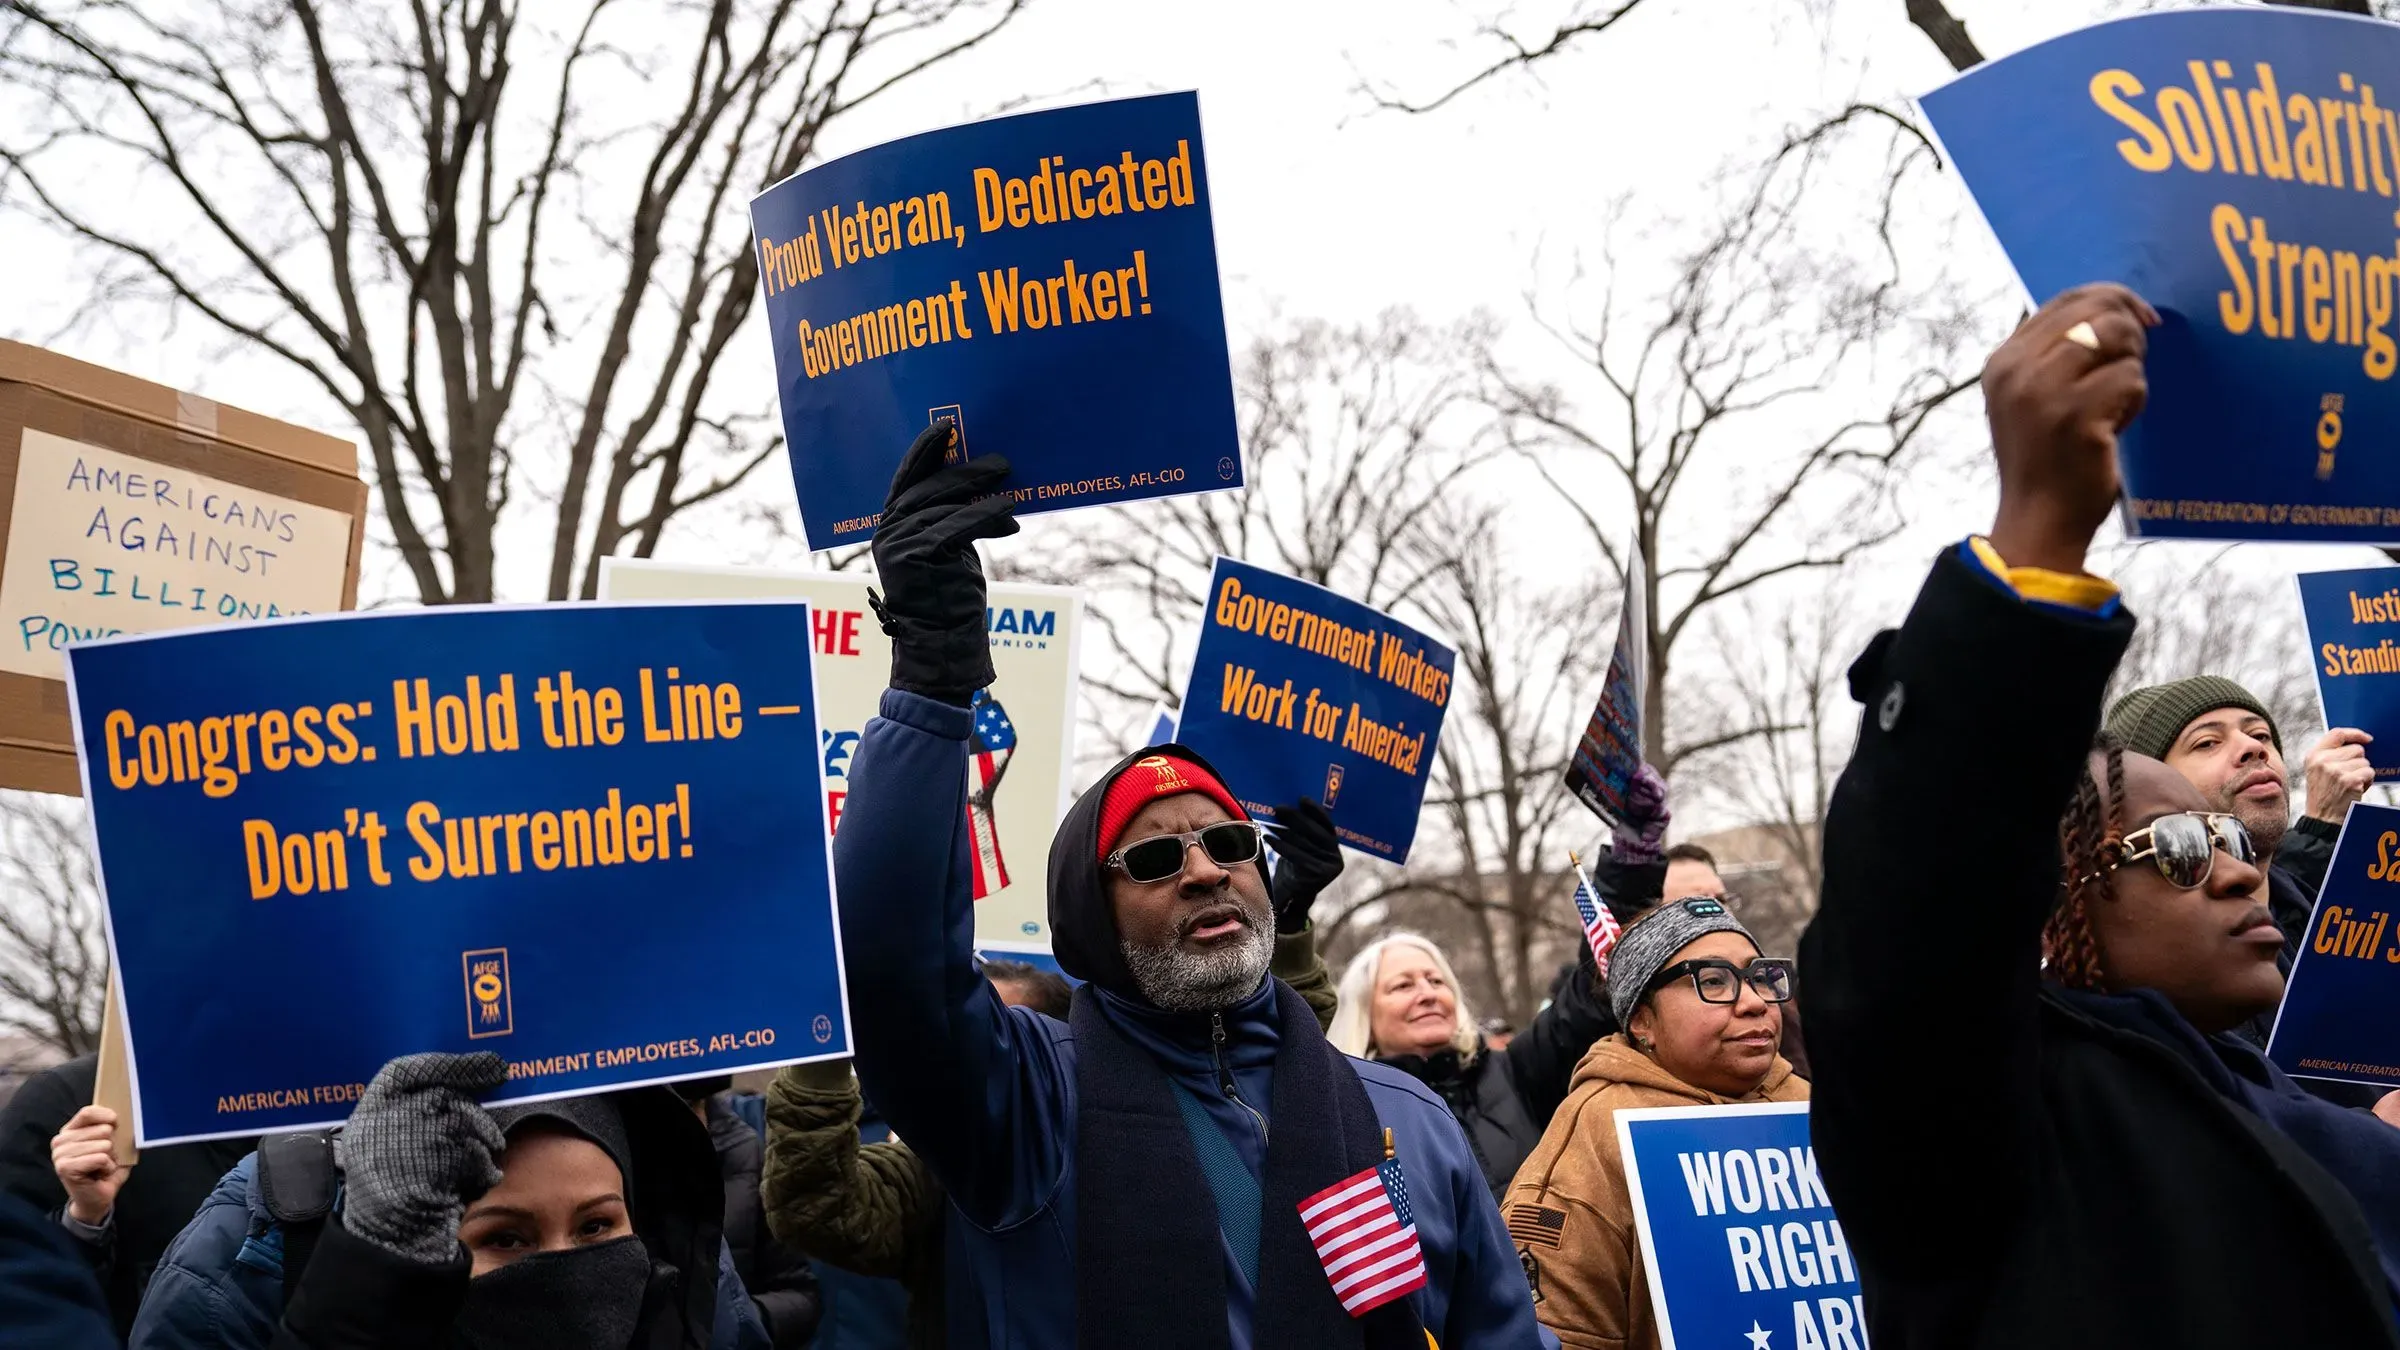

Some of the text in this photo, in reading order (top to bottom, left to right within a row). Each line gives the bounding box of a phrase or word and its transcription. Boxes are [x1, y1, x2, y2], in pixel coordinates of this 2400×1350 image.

[762, 139, 1196, 297] Proud Veteran, Dedicated
[799, 250, 1152, 379] Government Worker!
[2211, 203, 2400, 380] Streng
[66, 457, 298, 543] AMERICANS
[1037, 477, 1125, 499] EMPLOYEES,
[1129, 468, 1185, 486] AFL-CIO
[86, 506, 278, 577] AGAINST
[833, 515, 872, 535] AMERICAN
[50, 559, 311, 619] BILLIONA
[20, 615, 146, 651] POW
[991, 638, 1047, 650] UNION
[1215, 577, 1450, 708] Government Workers
[105, 701, 377, 799] Congress:
[393, 673, 518, 758] Hold
[534, 671, 624, 749] the
[638, 666, 742, 744] Line
[1220, 662, 1426, 777] Work for America!
[242, 783, 695, 900] Don’t Surrender!
[2314, 905, 2389, 960] Civil
[217, 1088, 309, 1114] AMERICAN
[507, 1051, 590, 1080] RNMENT
[595, 1039, 705, 1069] EMPLOYEES,
[708, 1028, 776, 1053] AFL-CIO
[2350, 1063, 2400, 1078] FEDERATIO
[1678, 1146, 1833, 1216] WORK
[1726, 1220, 1856, 1293] RIGH
[1792, 1295, 1872, 1350] AR
